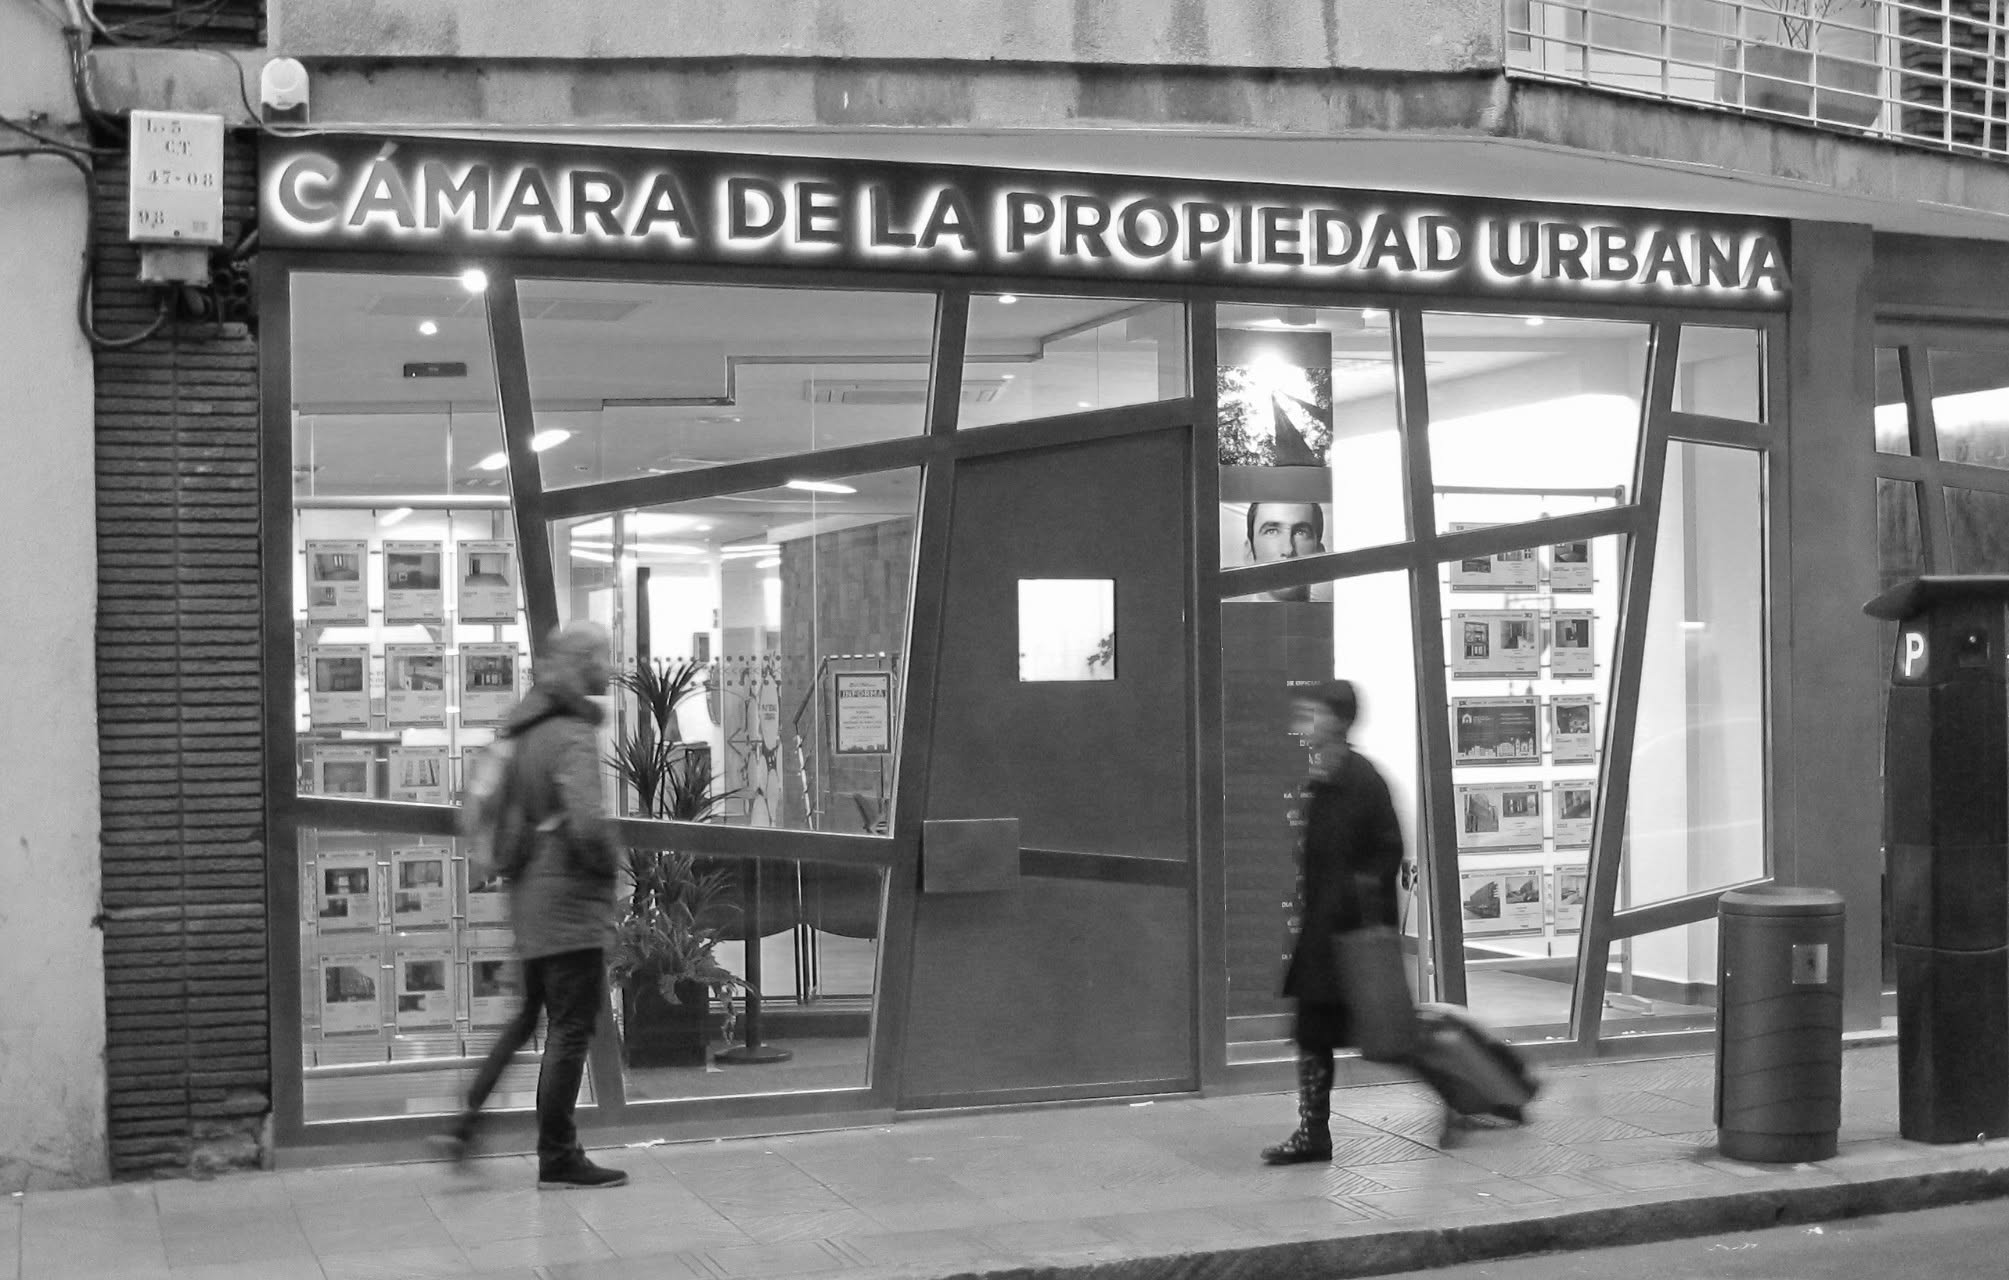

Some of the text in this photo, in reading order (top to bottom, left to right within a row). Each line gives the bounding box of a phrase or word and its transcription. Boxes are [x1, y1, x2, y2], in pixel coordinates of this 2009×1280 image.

[279, 141, 1790, 292] CÁMARA DE LA PROPIEDAD URBANA
[1905, 632, 1925, 677] P
